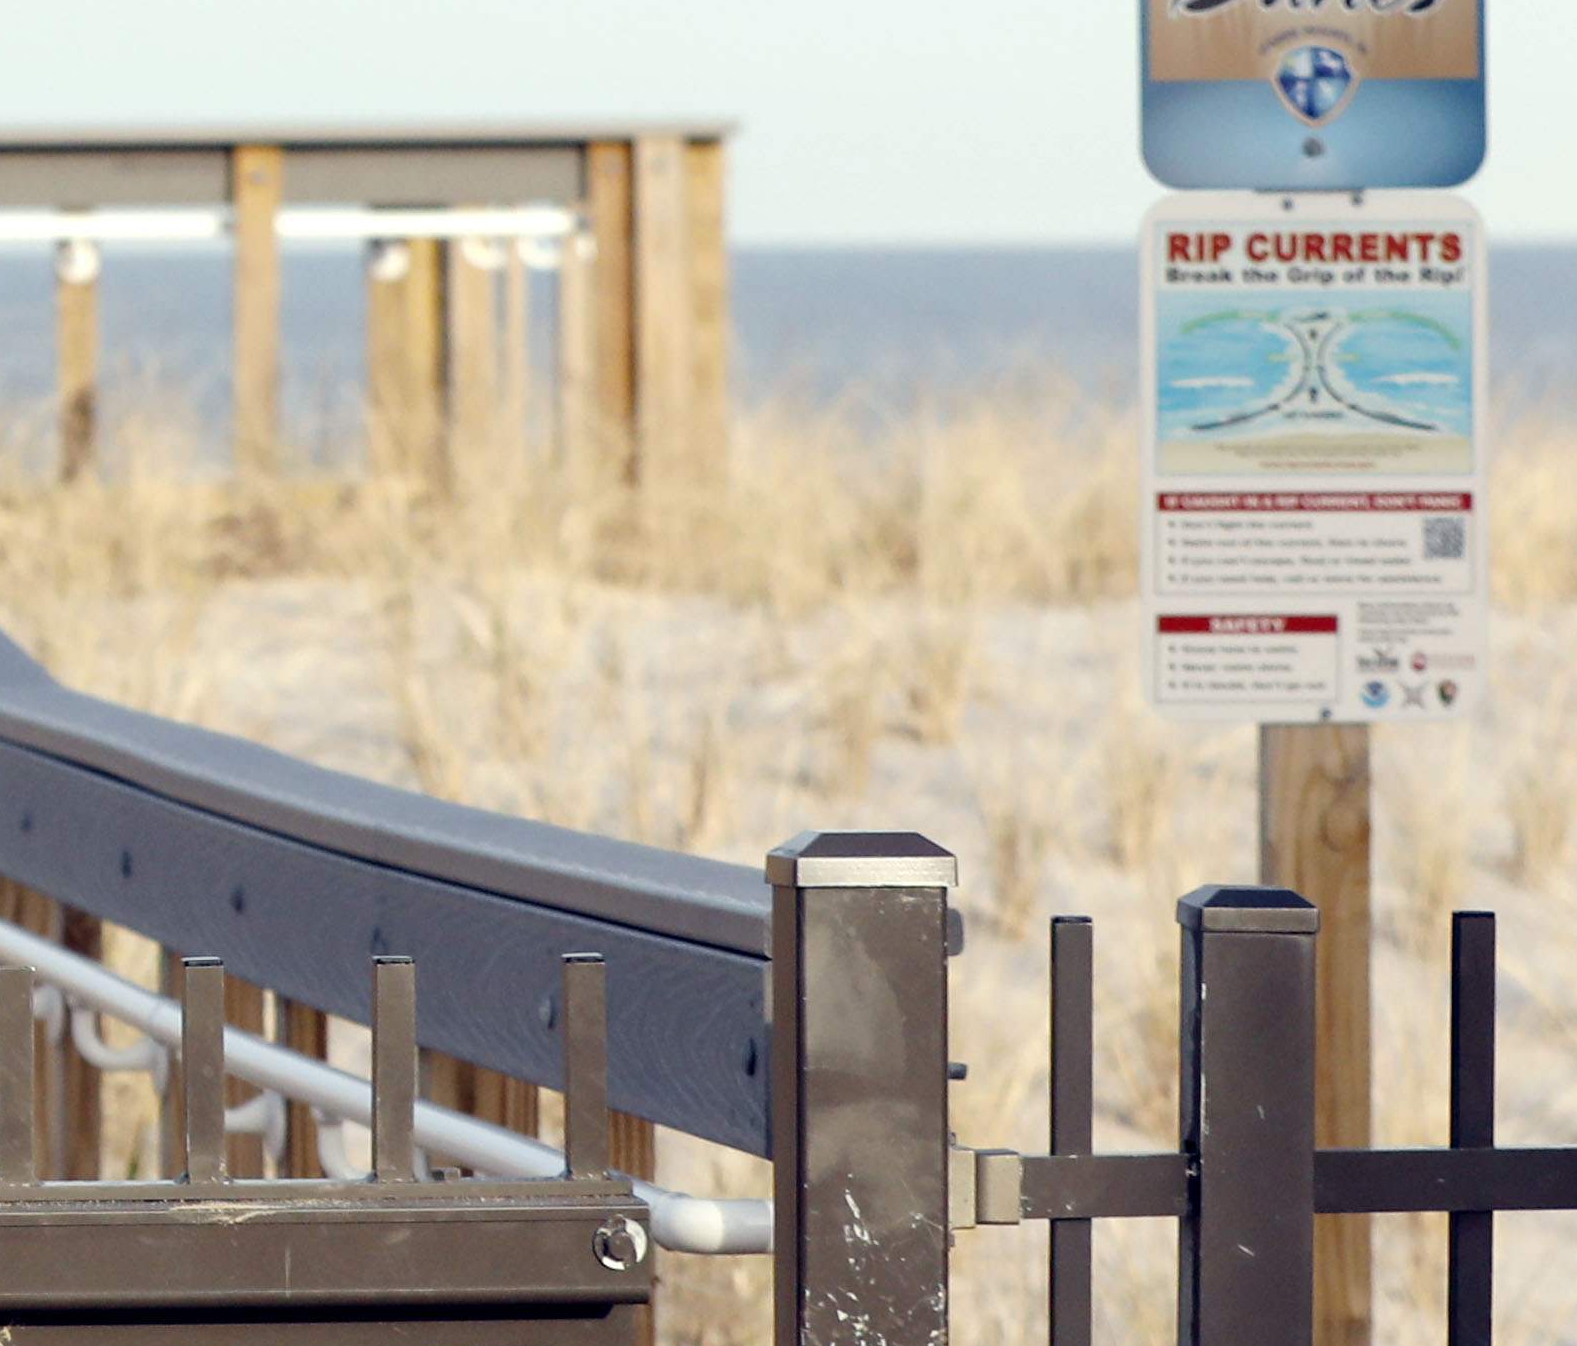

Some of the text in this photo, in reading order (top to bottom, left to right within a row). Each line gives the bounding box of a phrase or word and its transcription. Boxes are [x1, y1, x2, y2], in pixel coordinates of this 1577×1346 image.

[1168, 232, 1462, 262] RIP CURRENTS
[1166, 267, 1233, 284] Break
[1242, 266, 1278, 284] the
[1287, 266, 1335, 287] Grip
[1342, 266, 1365, 283] of
[1374, 266, 1410, 283] the
